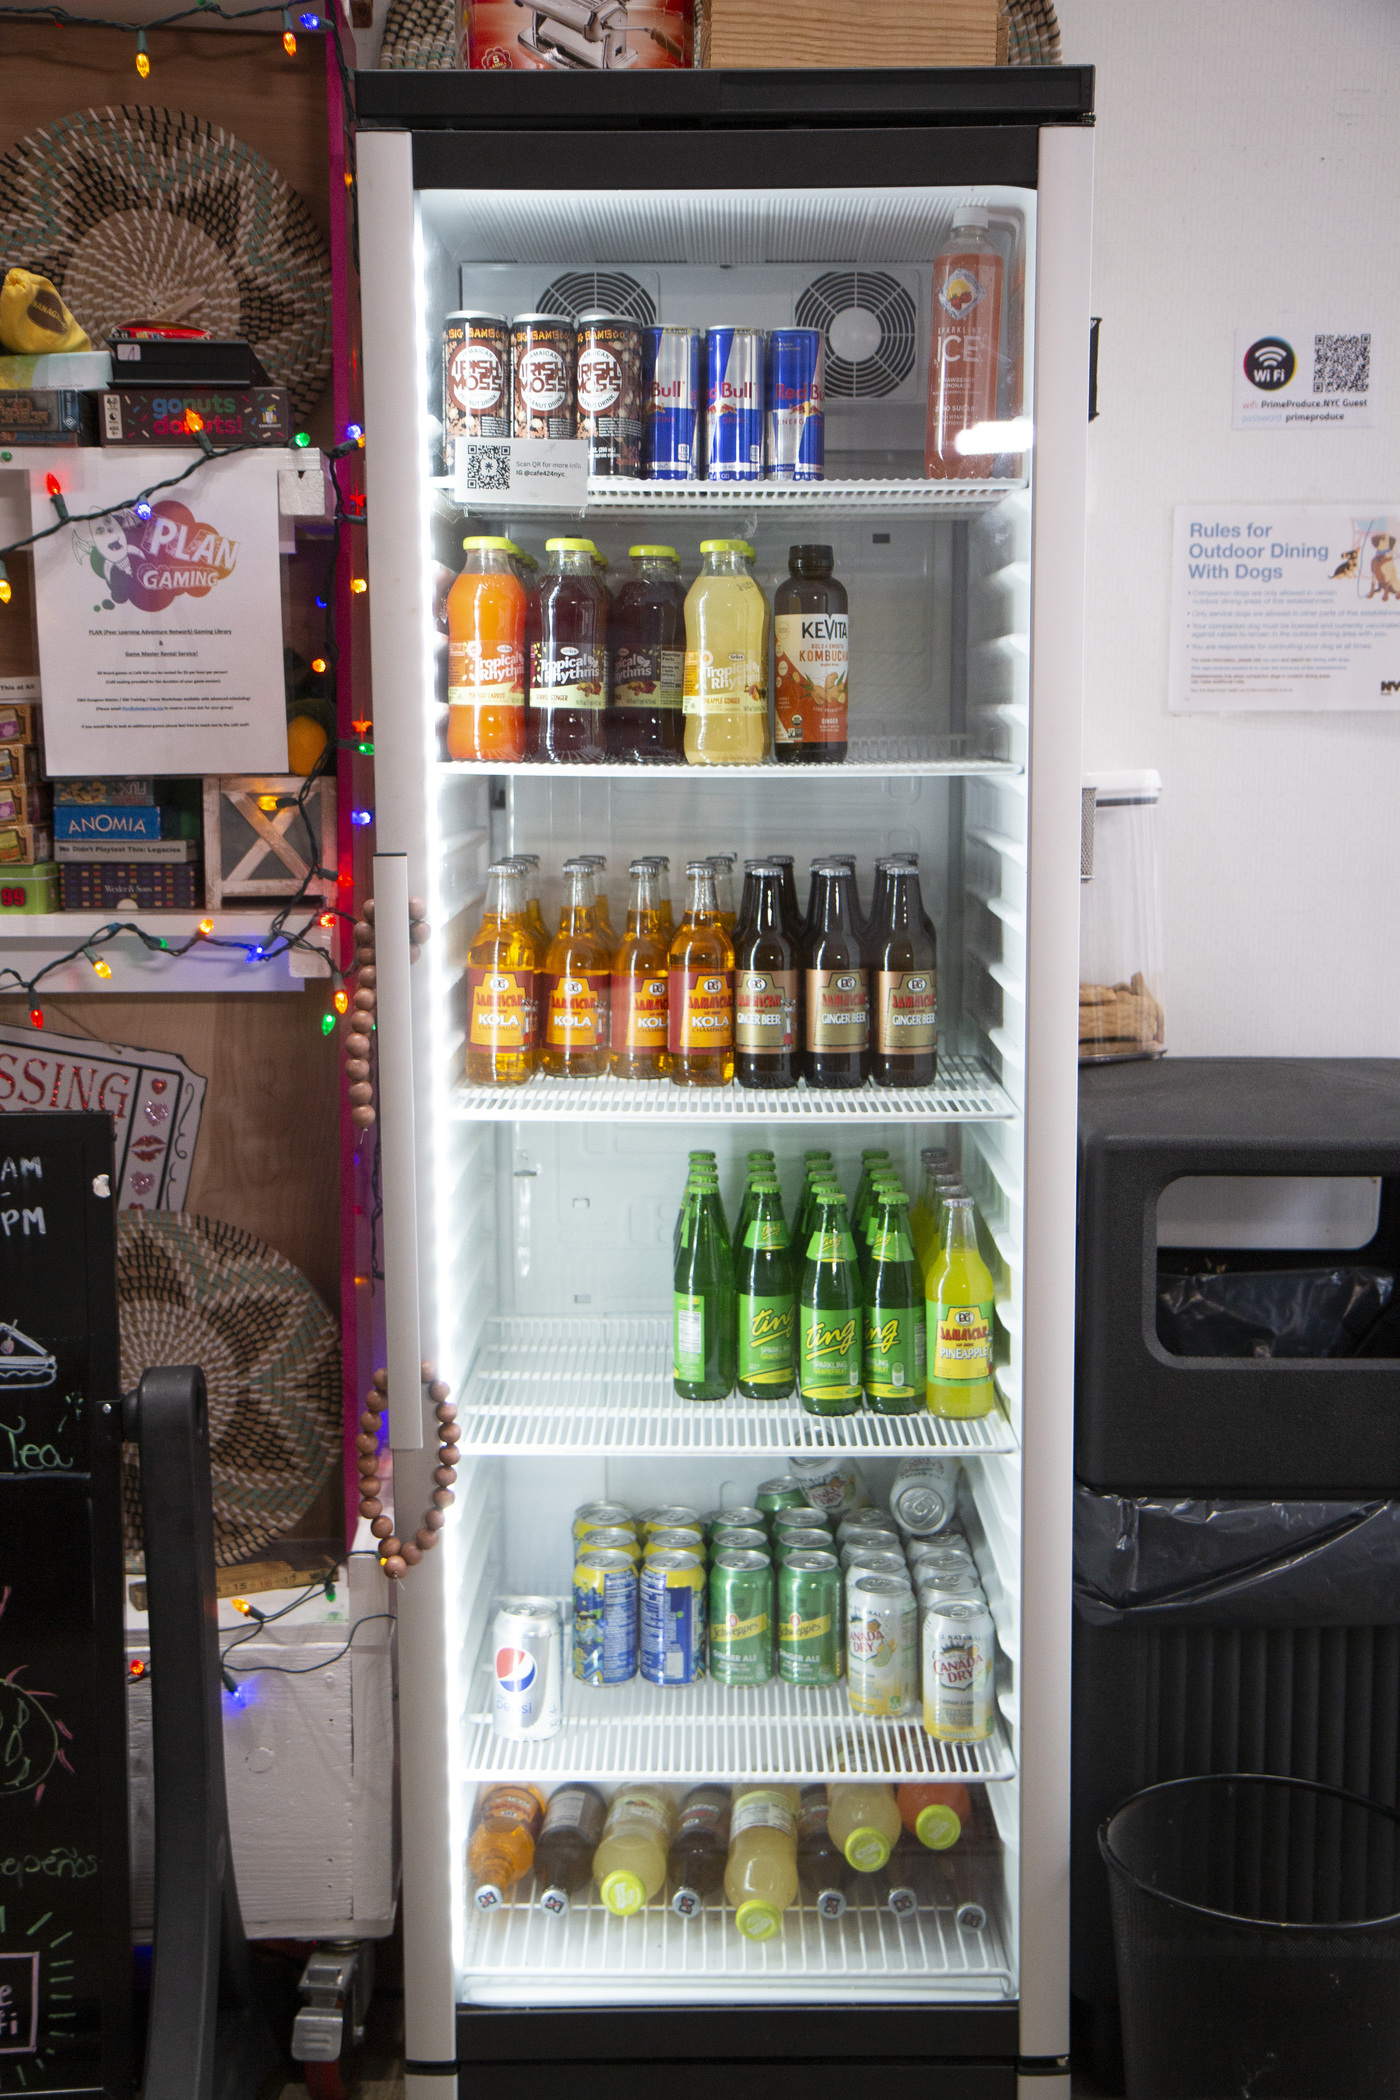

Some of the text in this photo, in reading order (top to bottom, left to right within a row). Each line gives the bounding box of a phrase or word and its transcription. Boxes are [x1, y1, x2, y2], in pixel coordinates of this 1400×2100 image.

[492, 55, 500, 64] 5
[448, 328, 504, 339] BIG BAMBOO
[531, 330, 568, 340] BAMBOO
[585, 330, 625, 341] BAMBOO
[530, 351, 558, 360] AMAICAN
[937, 335, 980, 362] ICE
[454, 360, 501, 376] IRISH
[520, 362, 565, 378] IRISH
[578, 362, 620, 380] IRISH
[1254, 369, 1285, 382] Wi Fi
[451, 375, 501, 392] MOSS
[520, 376, 566, 393] MOSS
[578, 378, 622, 394] MOSS
[650, 381, 681, 398] Bull
[721, 382, 752, 398] Bull
[776, 382, 807, 400] Red
[152, 394, 236, 420] gonuts
[598, 394, 615, 409] DRINK
[1261, 398, 1368, 408] PrimeProduce.NYC Guest
[1286, 413, 1344, 423] primeproduce
[1190, 522, 1273, 538] Rules for
[150, 518, 240, 570] PLAN
[1189, 543, 1329, 562] Outdoor Dining
[142, 570, 219, 590] GAMING
[1188, 564, 1283, 582] With Dogs
[473, 653, 519, 670] Tropical
[540, 654, 587, 670] Tropical
[545, 666, 599, 684] Rhythms
[707, 661, 753, 679] Tropical
[68, 814, 146, 834] ANOMIA
[1, 888, 26, 906] 99
[634, 999, 669, 1010] JAMAIC
[478, 1014, 519, 1026] KOLA
[554, 1015, 592, 1027] KOLA
[638, 1017, 668, 1027] KOL
[692, 1016, 730, 1027] KOLA
[738, 1014, 781, 1025] GINGER BEER
[822, 1012, 866, 1024] GINGER BEER
[893, 1015, 921, 1026] GINGER
[0, 1053, 130, 1118] SSING
[1, 1156, 43, 1182] AM
[1, 1206, 46, 1236] PM
[762, 1223, 780, 1236] ting
[752, 1303, 795, 1338] ting
[806, 1319, 855, 1355] ting
[865, 1319, 898, 1354] ing
[940, 1325, 987, 1340] JAMAICAN
[940, 1346, 988, 1360] PINEAPPLE
[813, 1360, 848, 1368] SPARKLING
[850, 1631, 884, 1640] ANADA
[933, 1654, 984, 1676] CANADA
[948, 1669, 973, 1683] DRY
[497, 1700, 532, 1714] pesi
